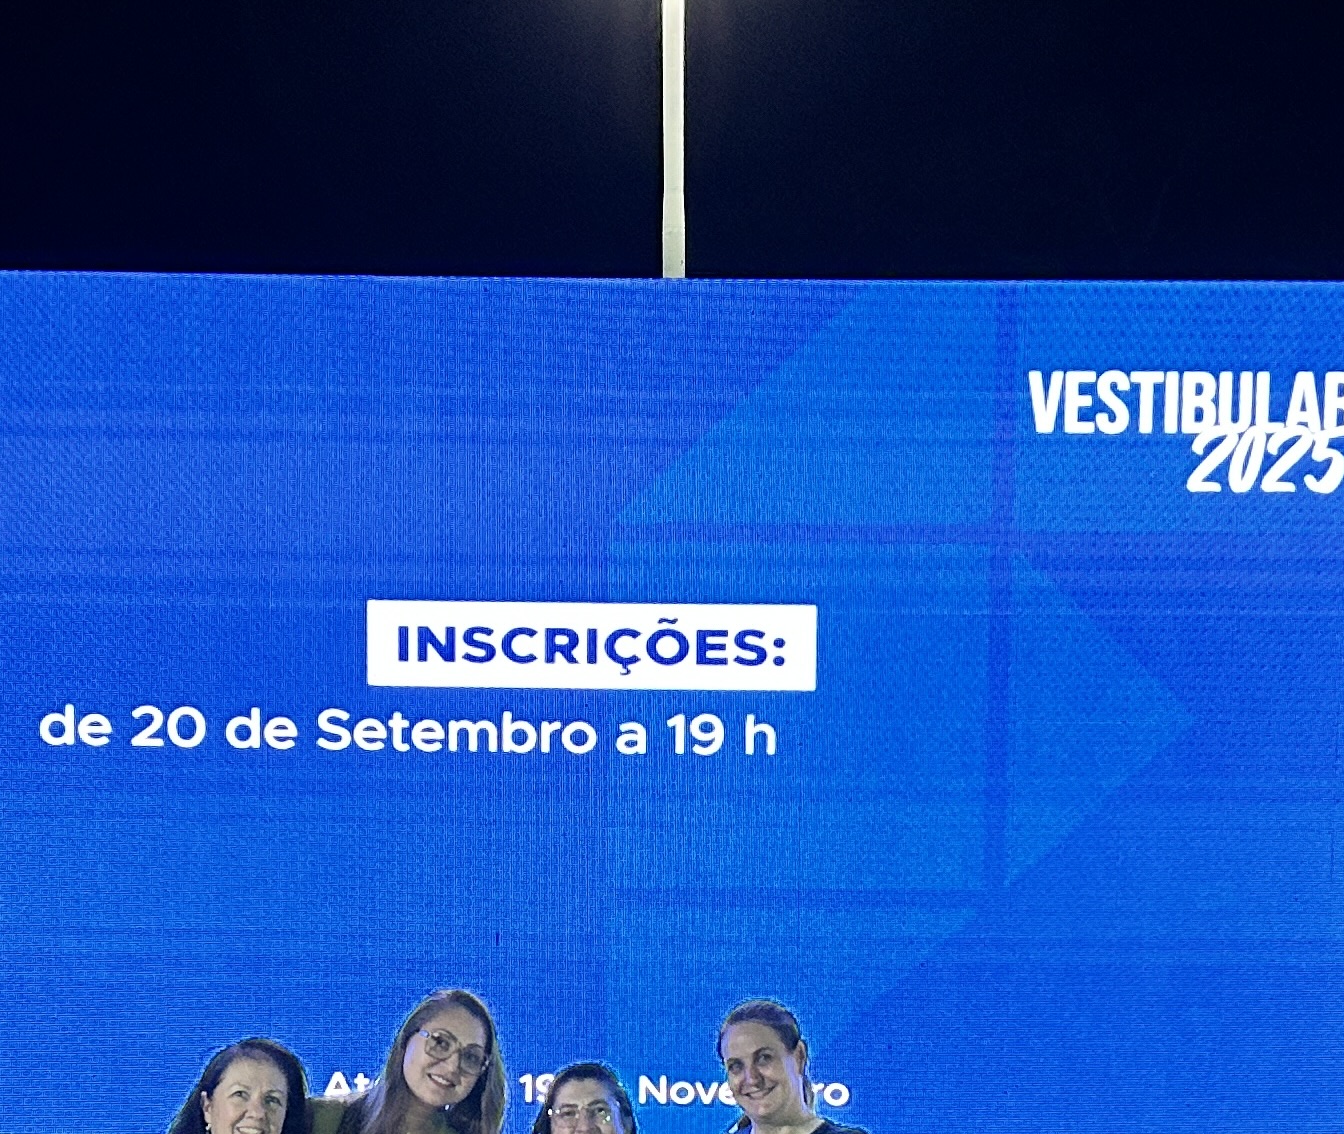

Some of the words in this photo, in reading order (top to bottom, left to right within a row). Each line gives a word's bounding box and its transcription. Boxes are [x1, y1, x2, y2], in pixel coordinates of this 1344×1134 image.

[398, 617, 786, 676] INSCRIÇÕES:
[39, 704, 113, 747] de
[130, 705, 207, 749] 20
[225, 707, 298, 750] de
[316, 708, 597, 755] Setembro
[615, 721, 647, 755] a
[666, 713, 725, 756] 19
[745, 714, 776, 756] h
[323, 1071, 381, 1098] At
[638, 1075, 850, 1107] Novero
